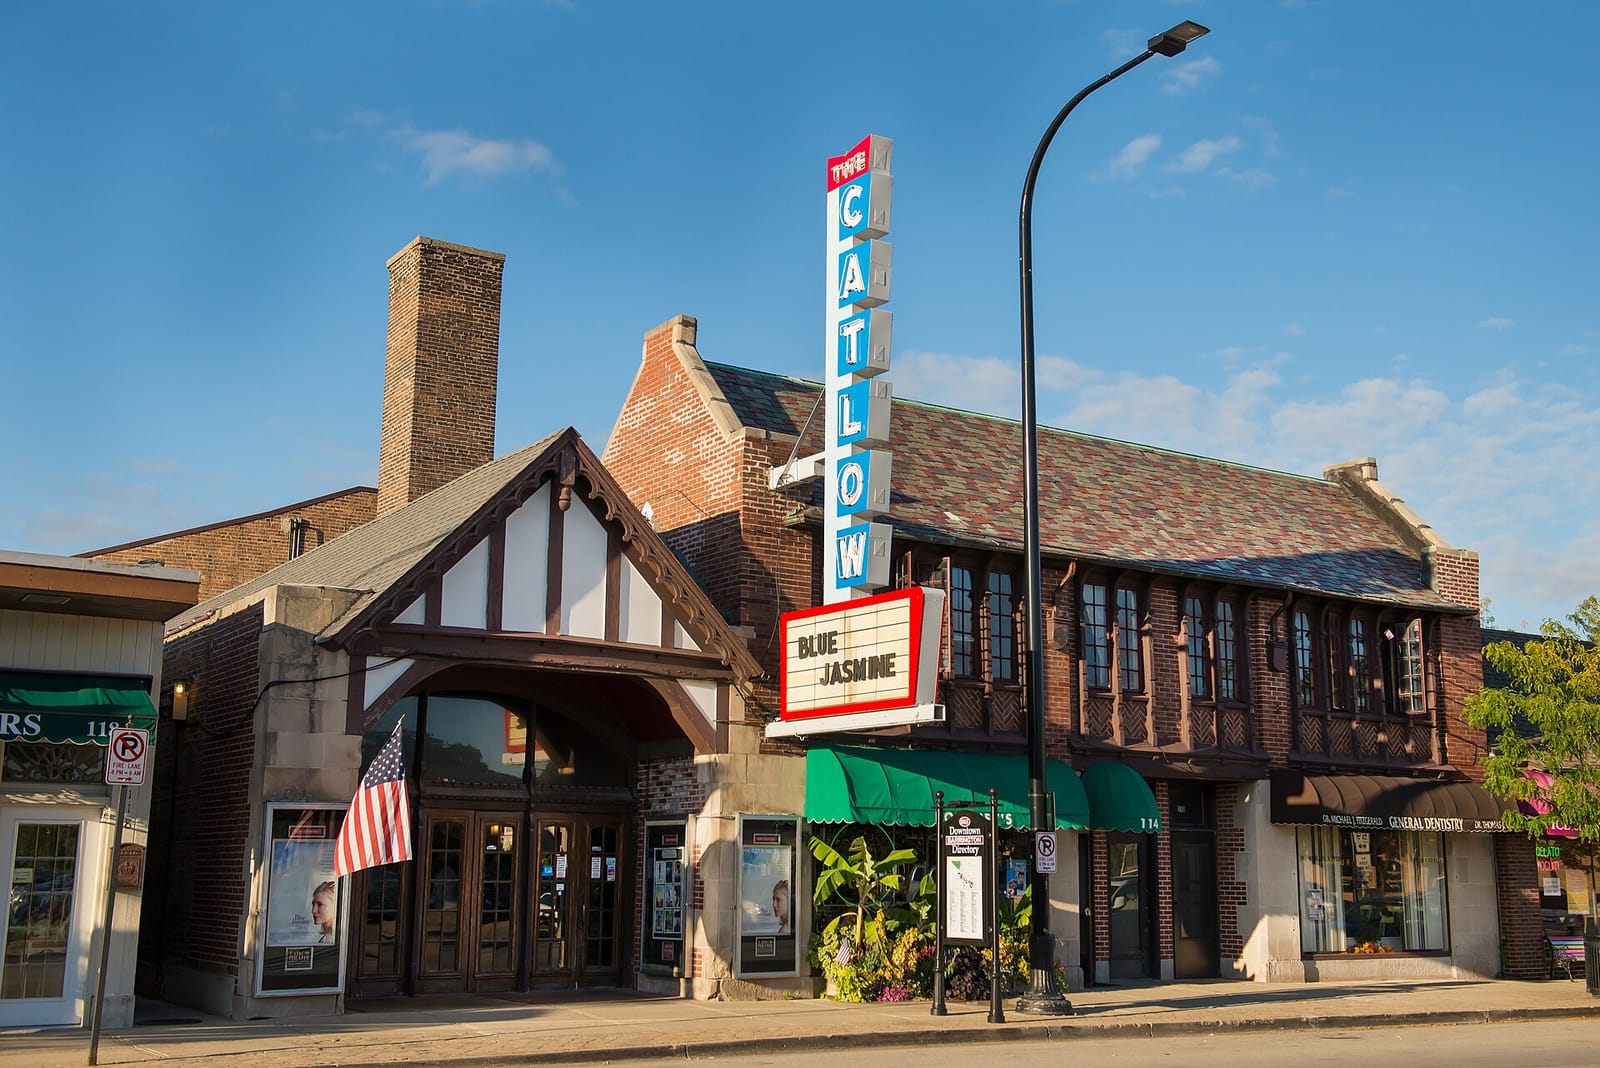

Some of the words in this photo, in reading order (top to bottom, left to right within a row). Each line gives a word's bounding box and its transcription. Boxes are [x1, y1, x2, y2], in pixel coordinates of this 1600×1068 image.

[831, 151, 866, 184] THE
[837, 184, 866, 580] CATLOW
[798, 630, 838, 660] BLUE
[819, 652, 896, 686] JASMINE
[949, 826, 981, 835] Downtown
[1140, 817, 1159, 829] 114
[1331, 815, 1352, 825] MICHAEL
[1388, 816, 1423, 829] GENERAL
[1424, 817, 1464, 832] DENTISTRY
[952, 845, 979, 856] Directory
[1535, 846, 1560, 857] GELATO
